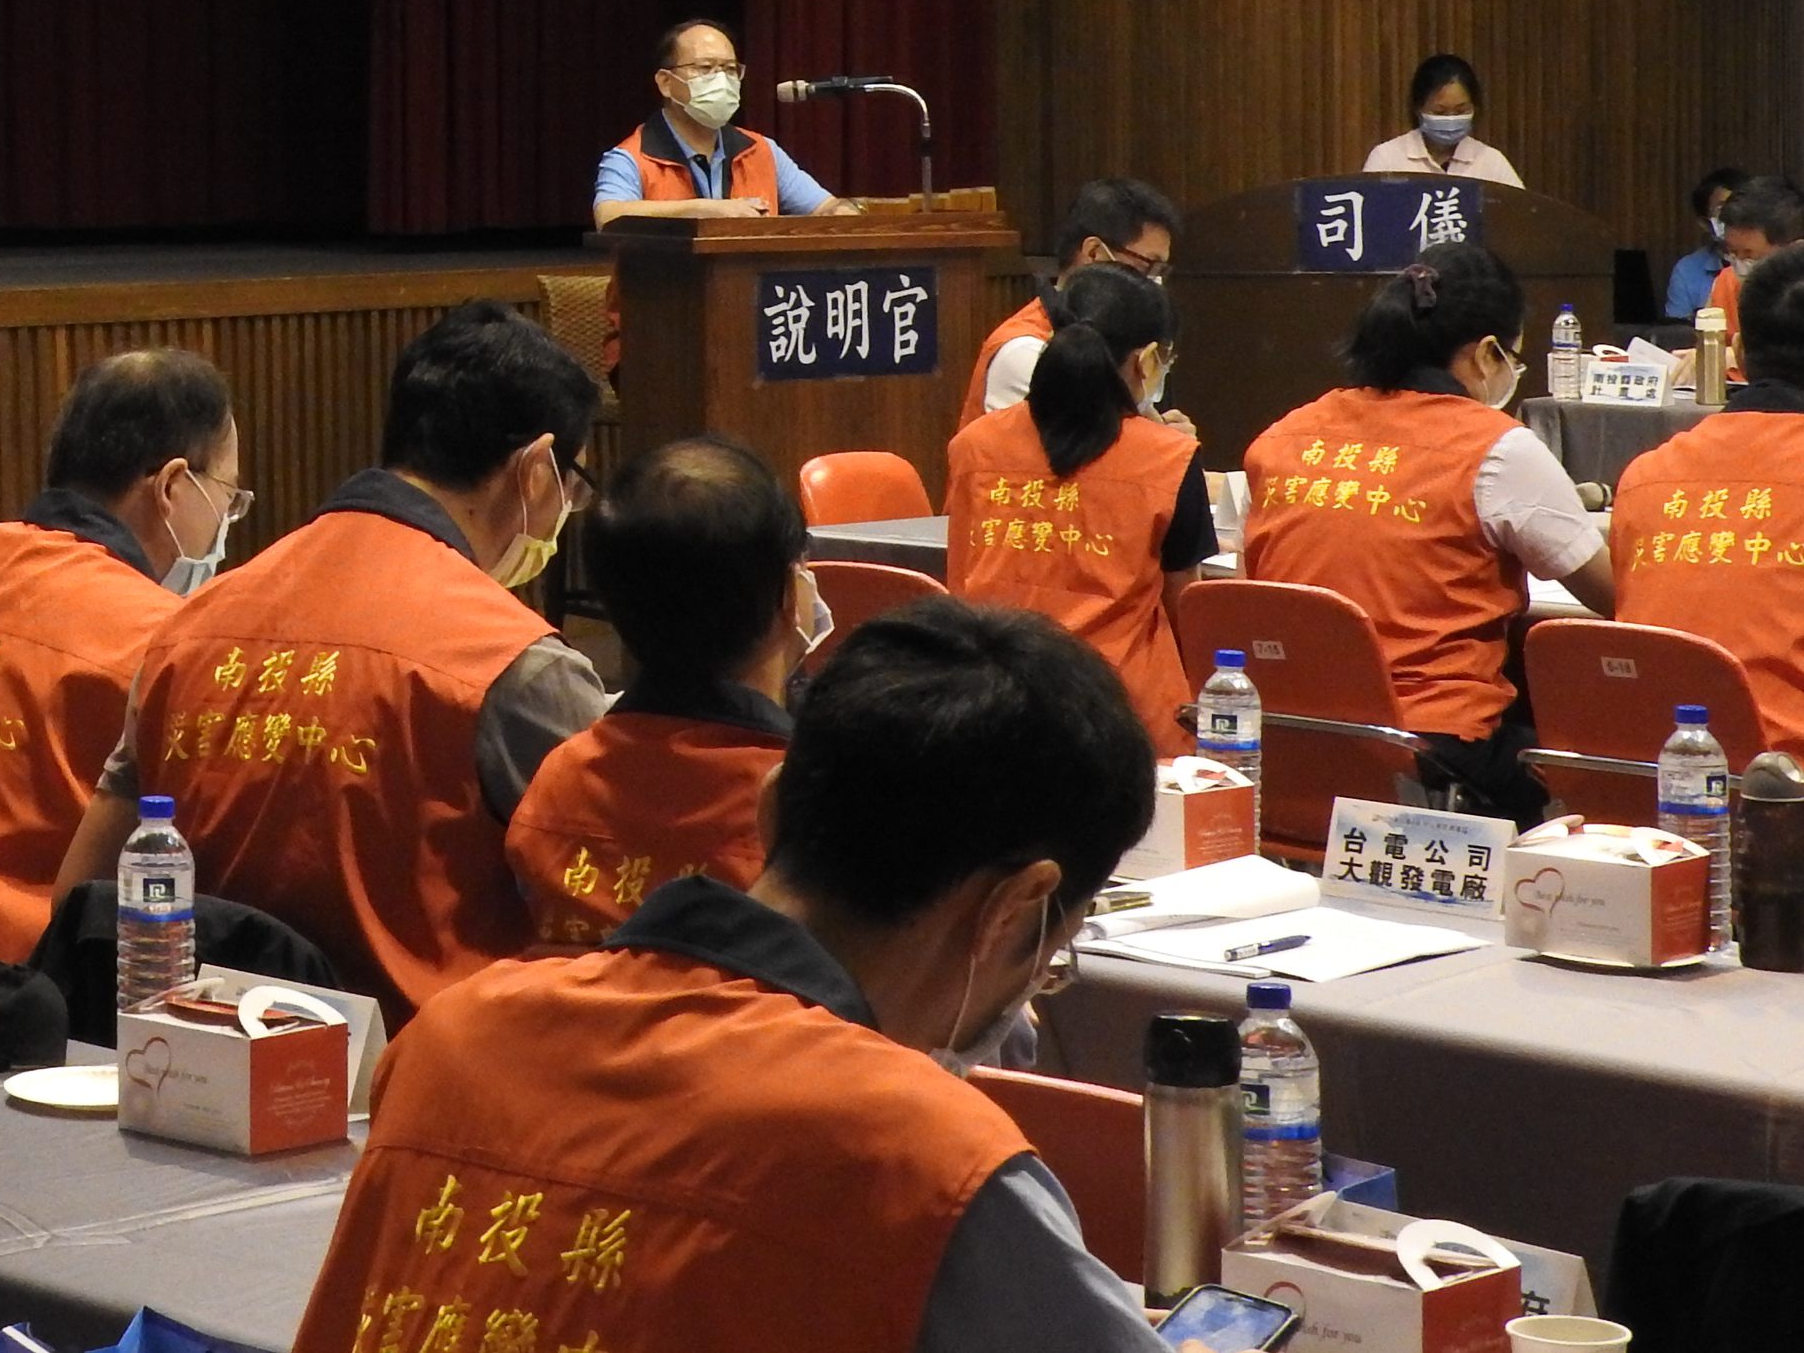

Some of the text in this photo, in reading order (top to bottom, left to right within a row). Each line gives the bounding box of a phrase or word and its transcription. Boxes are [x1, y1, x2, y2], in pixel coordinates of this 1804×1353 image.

[1315, 186, 1468, 262] 司儀
[763, 273, 929, 365] 說明官
[1302, 439, 1399, 475] 南投縣
[990, 477, 1080, 512] 南投縣
[1262, 475, 1427, 523] 災害應變中心
[1662, 487, 1773, 520] 南投縣
[970, 517, 1114, 556] 害應變中心
[214, 646, 341, 696] 南投縣
[1343, 826, 1492, 872] 台電公司
[564, 846, 709, 907] 南投
[1336, 856, 1489, 902] 大觀發電廠
[414, 1173, 632, 1290] 南投縣
